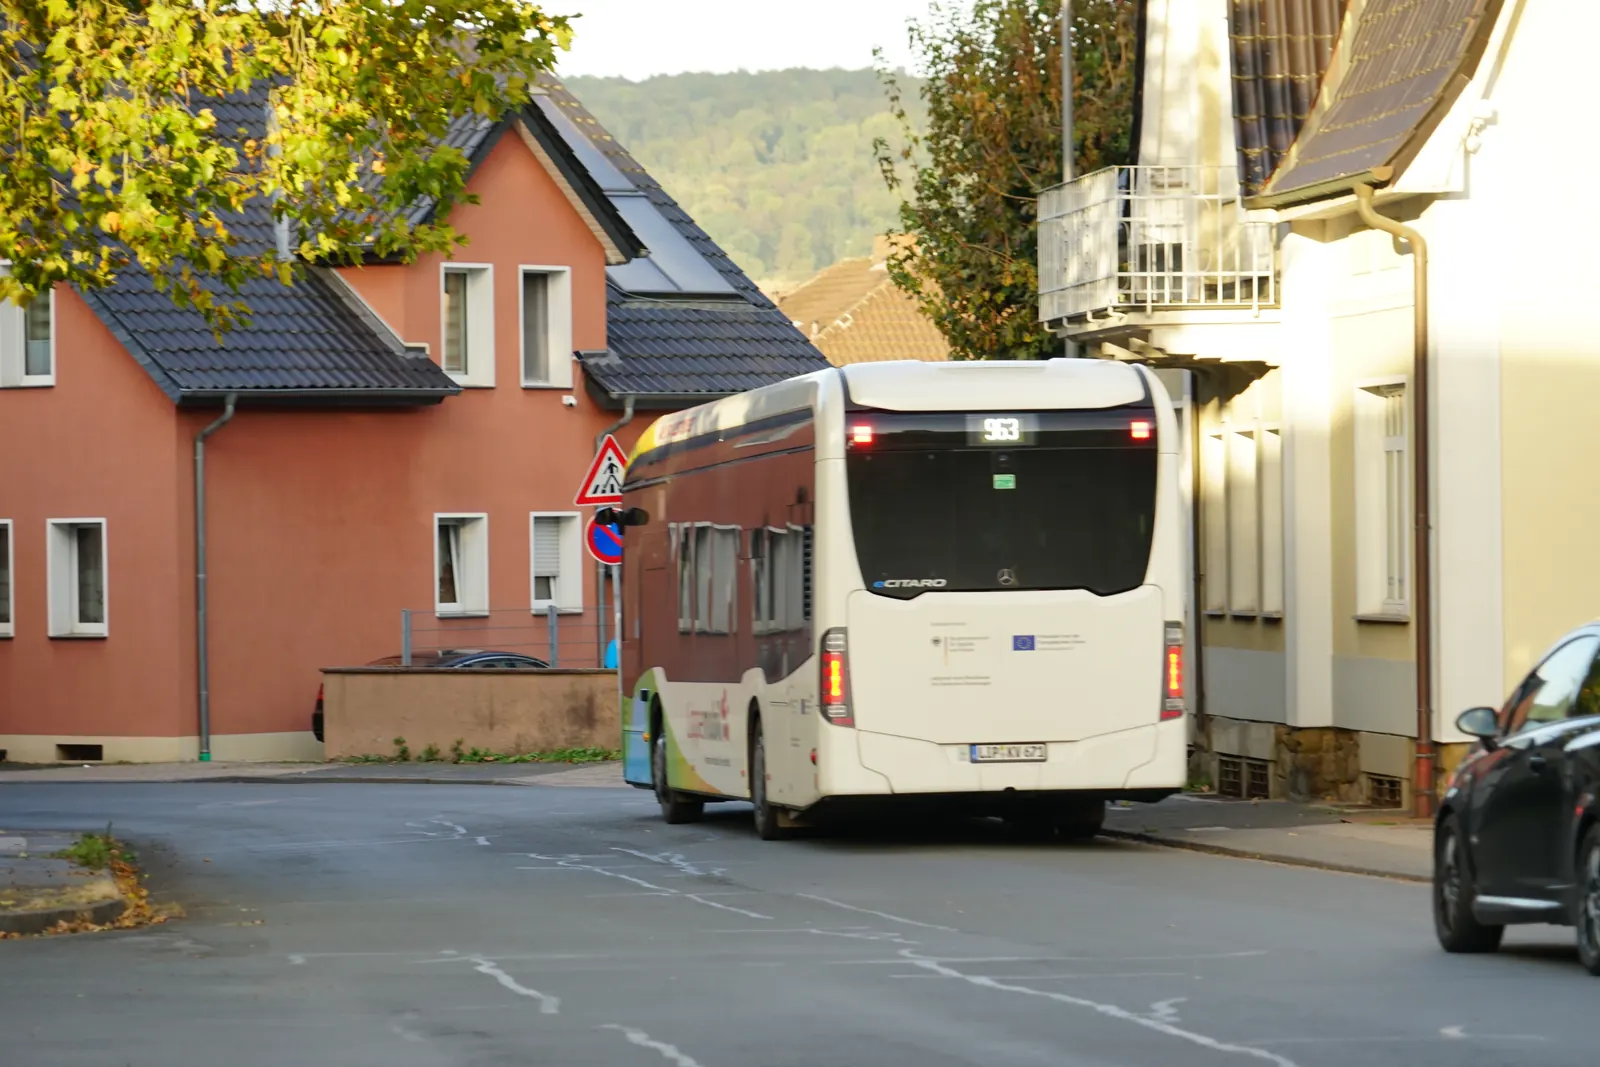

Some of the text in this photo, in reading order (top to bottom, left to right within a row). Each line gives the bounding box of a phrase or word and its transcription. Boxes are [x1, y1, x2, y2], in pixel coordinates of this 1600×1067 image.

[984, 418, 1019, 440] 963
[873, 579, 947, 588] eCITARO
[979, 746, 999, 758] LIP
